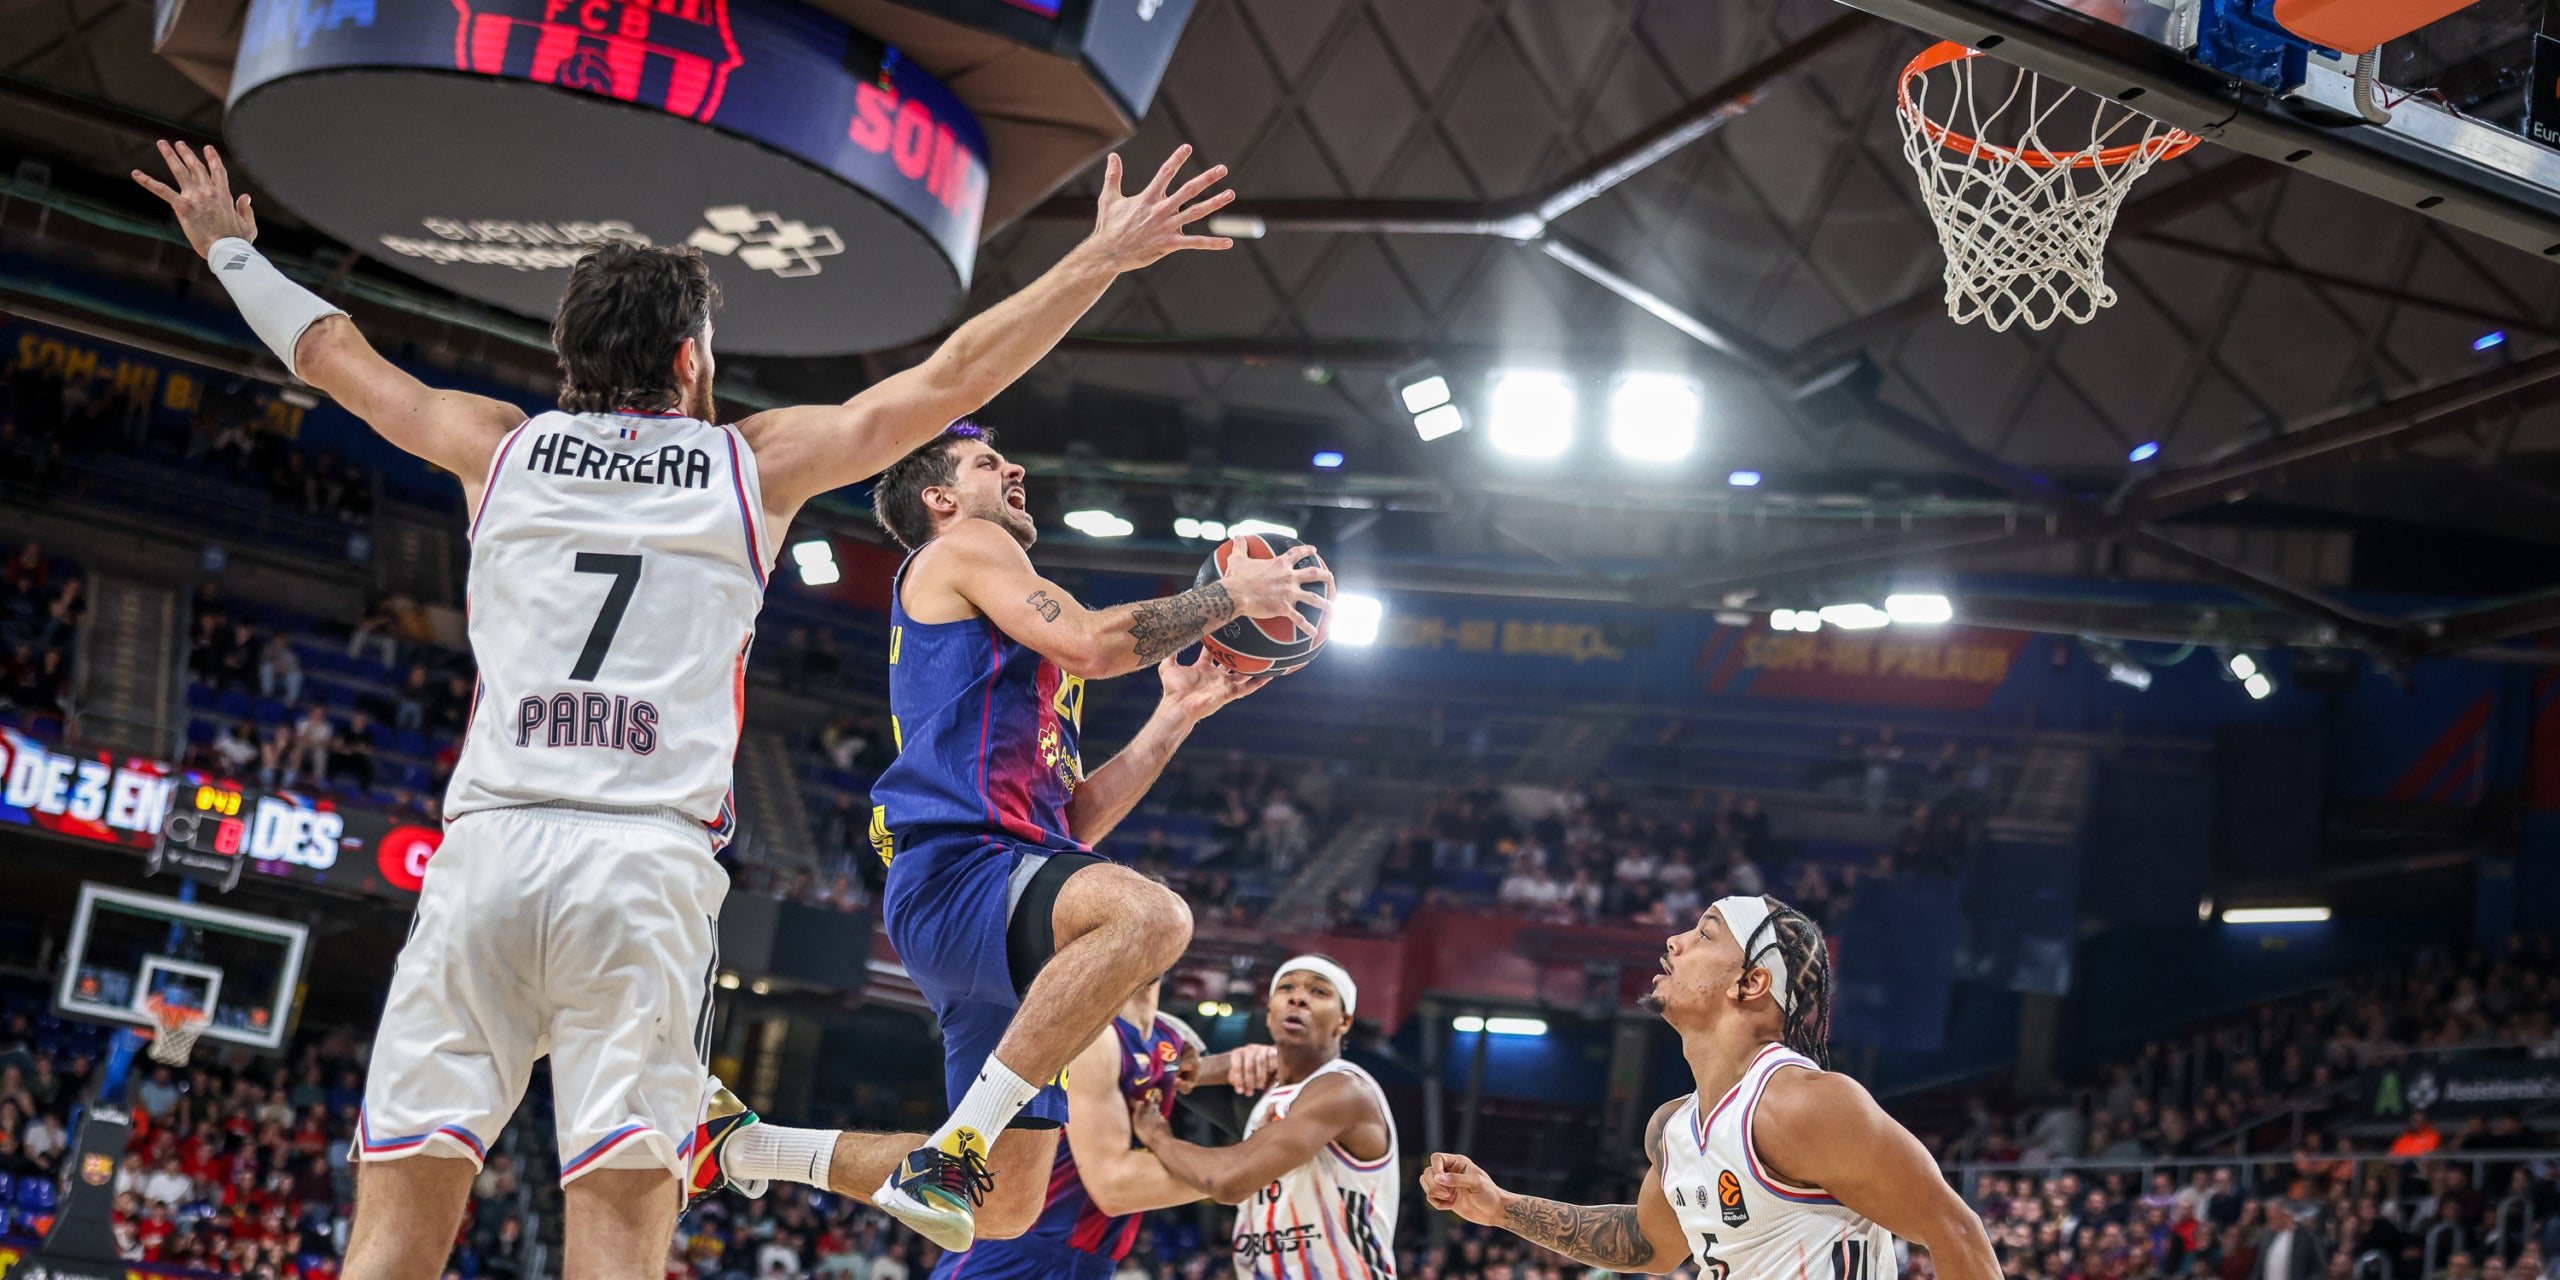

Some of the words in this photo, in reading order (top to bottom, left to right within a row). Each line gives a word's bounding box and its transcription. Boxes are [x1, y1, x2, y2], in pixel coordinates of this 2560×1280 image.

[2533, 121, 2560, 144] Eur
[527, 432, 710, 489] HERRERA
[568, 551, 643, 682] 7
[516, 691, 659, 756] PARIS
[240, 796, 345, 870] DES
